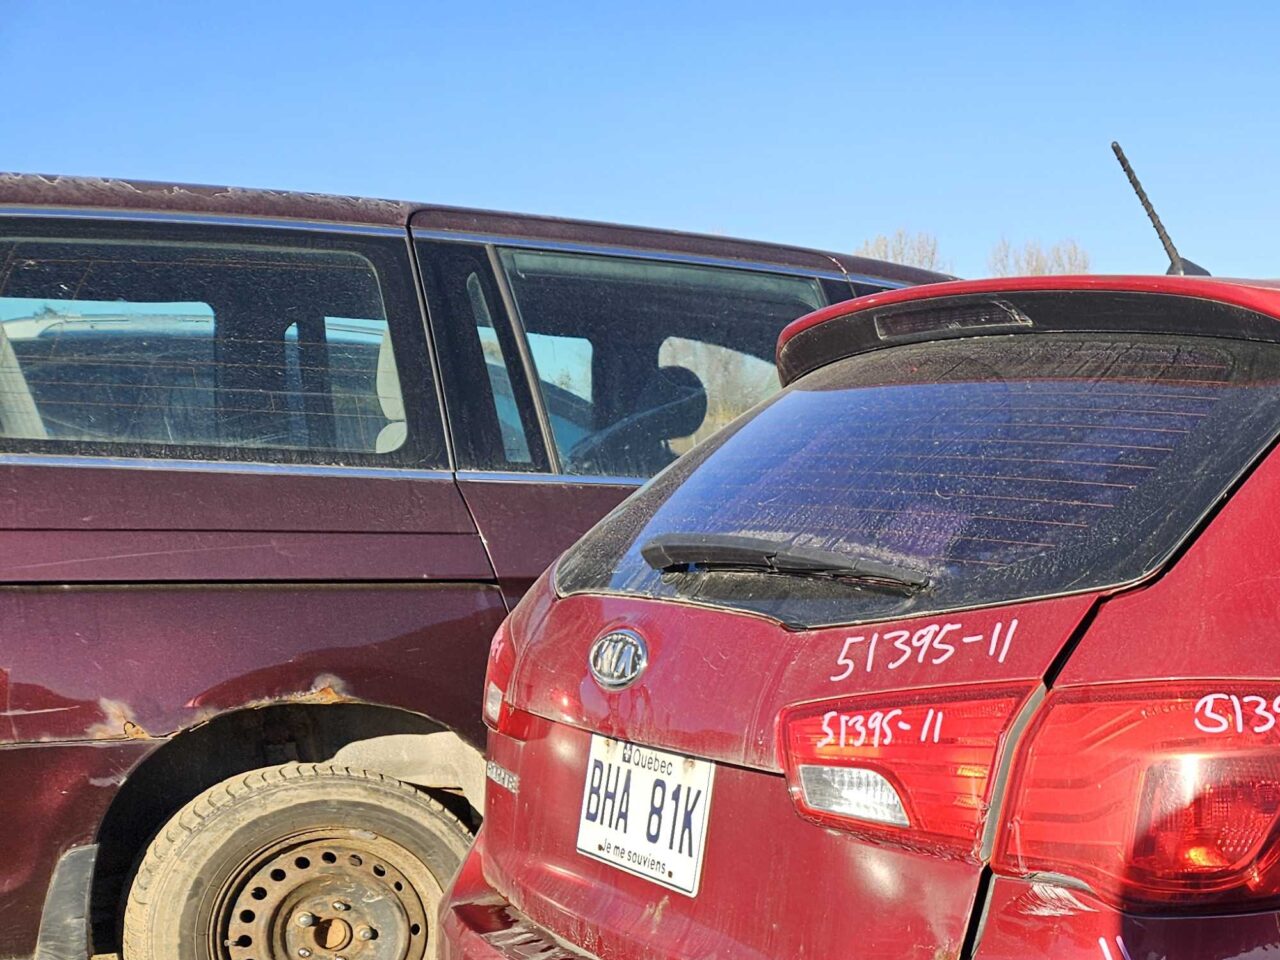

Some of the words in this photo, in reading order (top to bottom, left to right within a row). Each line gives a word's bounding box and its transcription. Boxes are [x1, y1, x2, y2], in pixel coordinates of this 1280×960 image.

[830, 618, 1018, 682] 51395-11
[816, 708, 943, 748] 51395-11
[632, 748, 673, 776] Québec
[585, 758, 632, 834] BHA
[646, 778, 702, 858] 81K
[602, 838, 612, 854] Je
[613, 845, 626, 859] me
[627, 852, 667, 875] souviens
